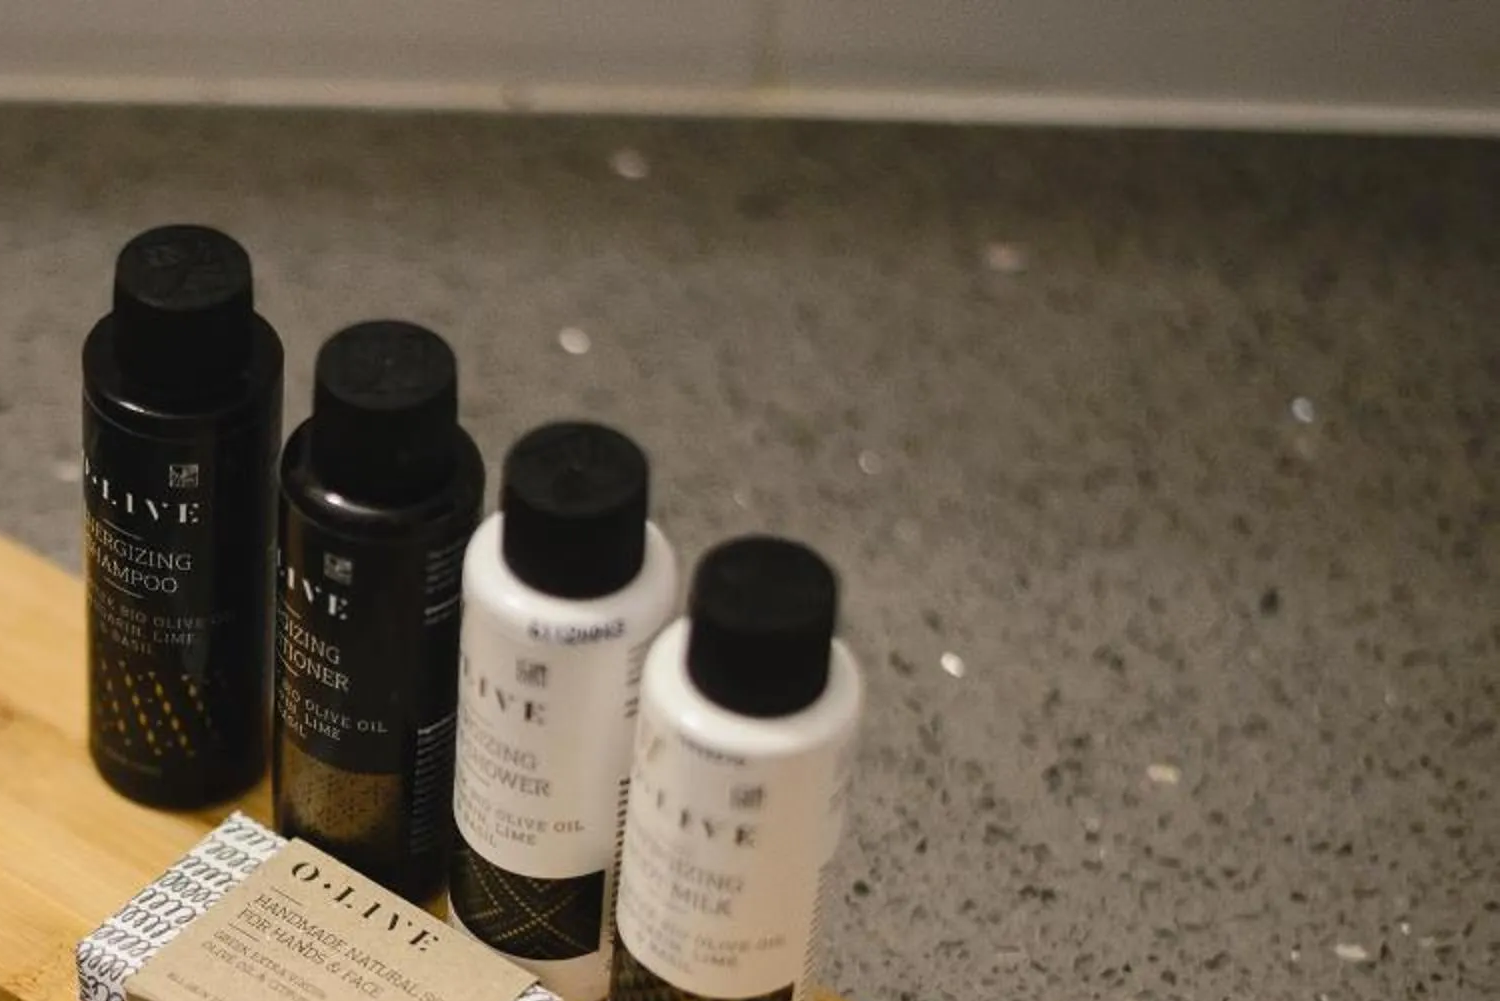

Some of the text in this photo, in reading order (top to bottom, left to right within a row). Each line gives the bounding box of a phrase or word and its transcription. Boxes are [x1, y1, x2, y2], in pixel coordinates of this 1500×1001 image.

[357, 719, 389, 734] OIL
[552, 819, 585, 833] OIL
[237, 905, 271, 931] FOR
[270, 927, 325, 964] HANDS
[342, 970, 384, 999] FACE
[252, 894, 348, 951] HANDMADE
[345, 948, 418, 997] NATURAL
